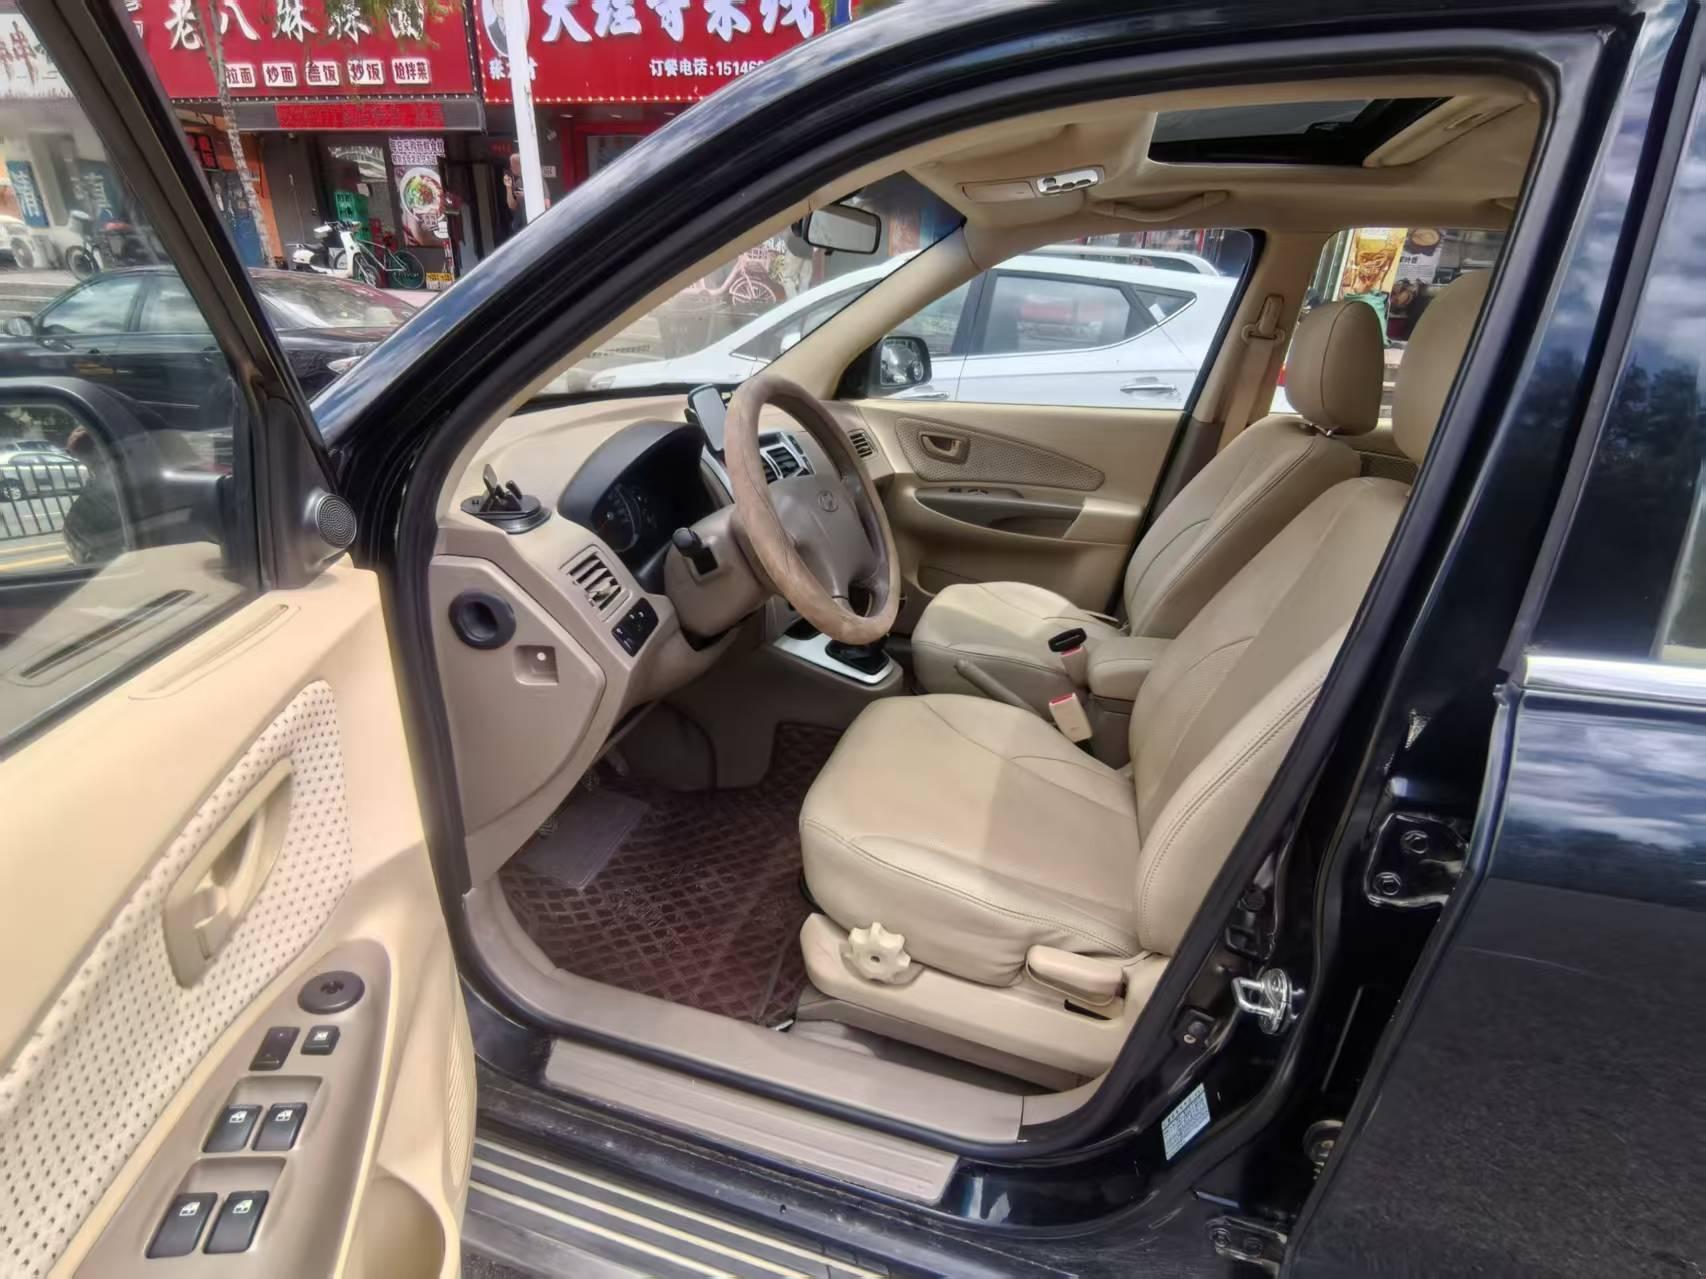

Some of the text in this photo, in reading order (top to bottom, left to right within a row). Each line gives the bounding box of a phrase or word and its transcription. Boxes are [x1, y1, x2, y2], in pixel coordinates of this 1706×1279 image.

[225, 67, 252, 84] 拉面
[266, 66, 294, 83] 炒面
[308, 64, 337, 83] 盖饭
[350, 63, 381, 81] 炒饭
[649, 58, 764, 77] 订餐电话:15146
